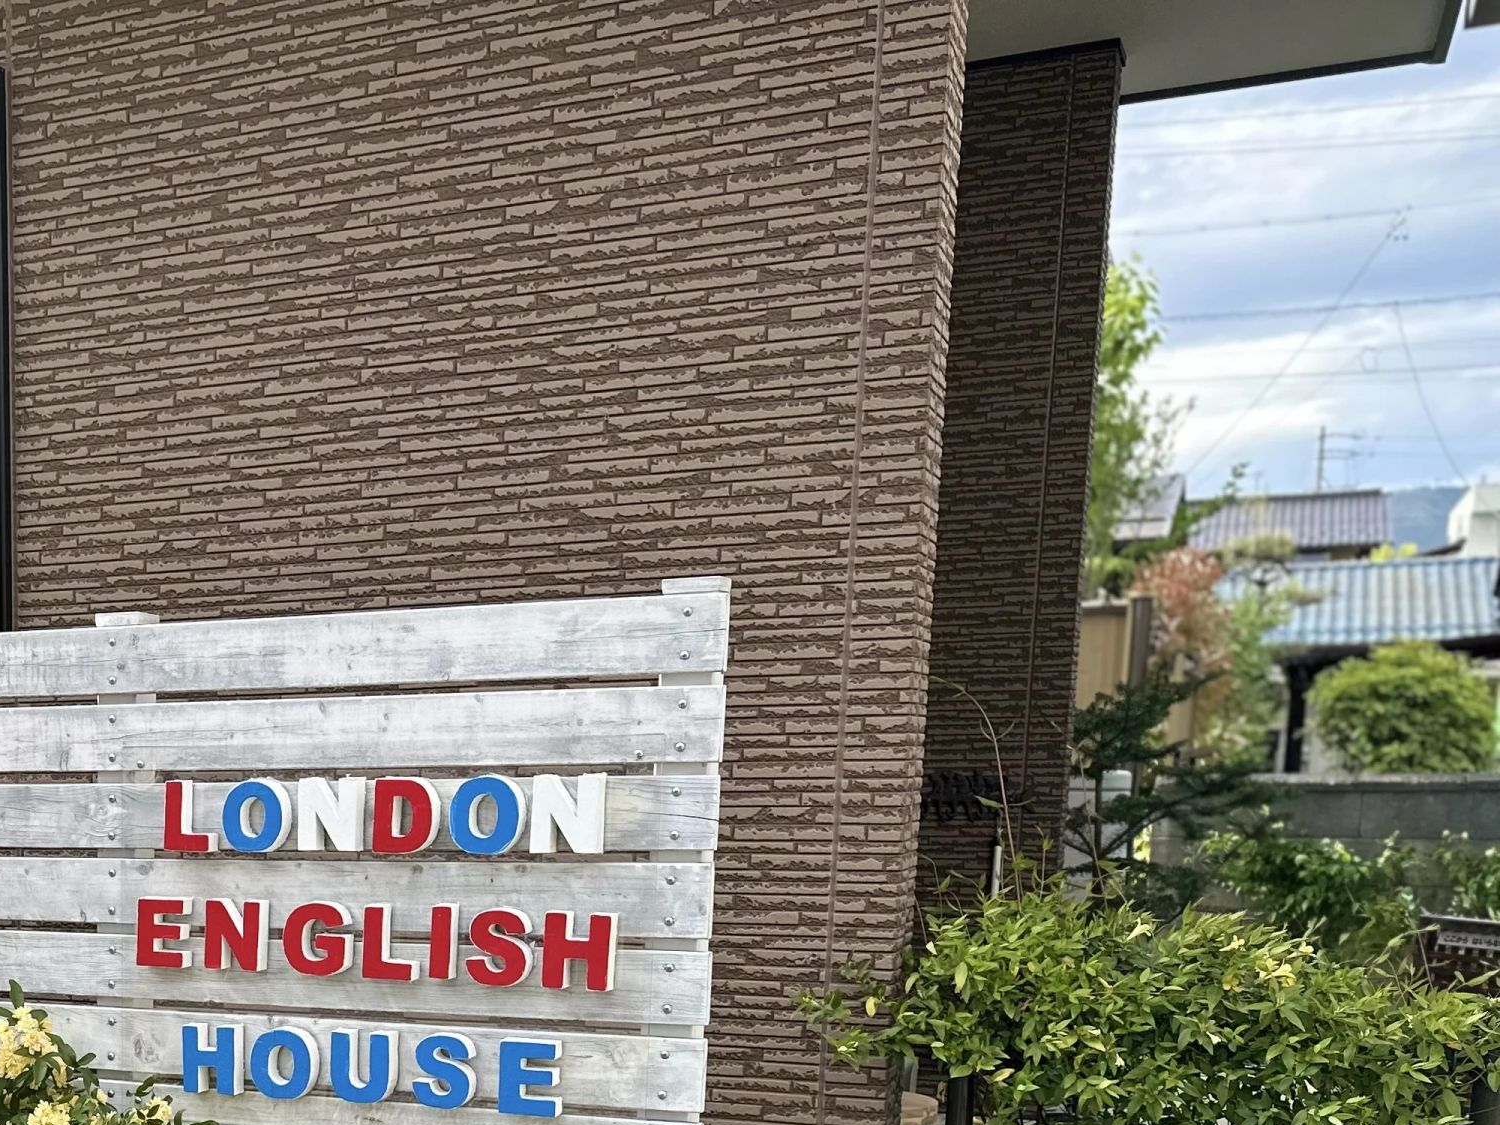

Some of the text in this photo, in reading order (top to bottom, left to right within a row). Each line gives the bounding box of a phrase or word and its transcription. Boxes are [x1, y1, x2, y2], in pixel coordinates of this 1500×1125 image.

[163, 772, 608, 855] LONDON
[135, 896, 619, 992] ENGLISH
[182, 1022, 562, 1118] HOUSE
